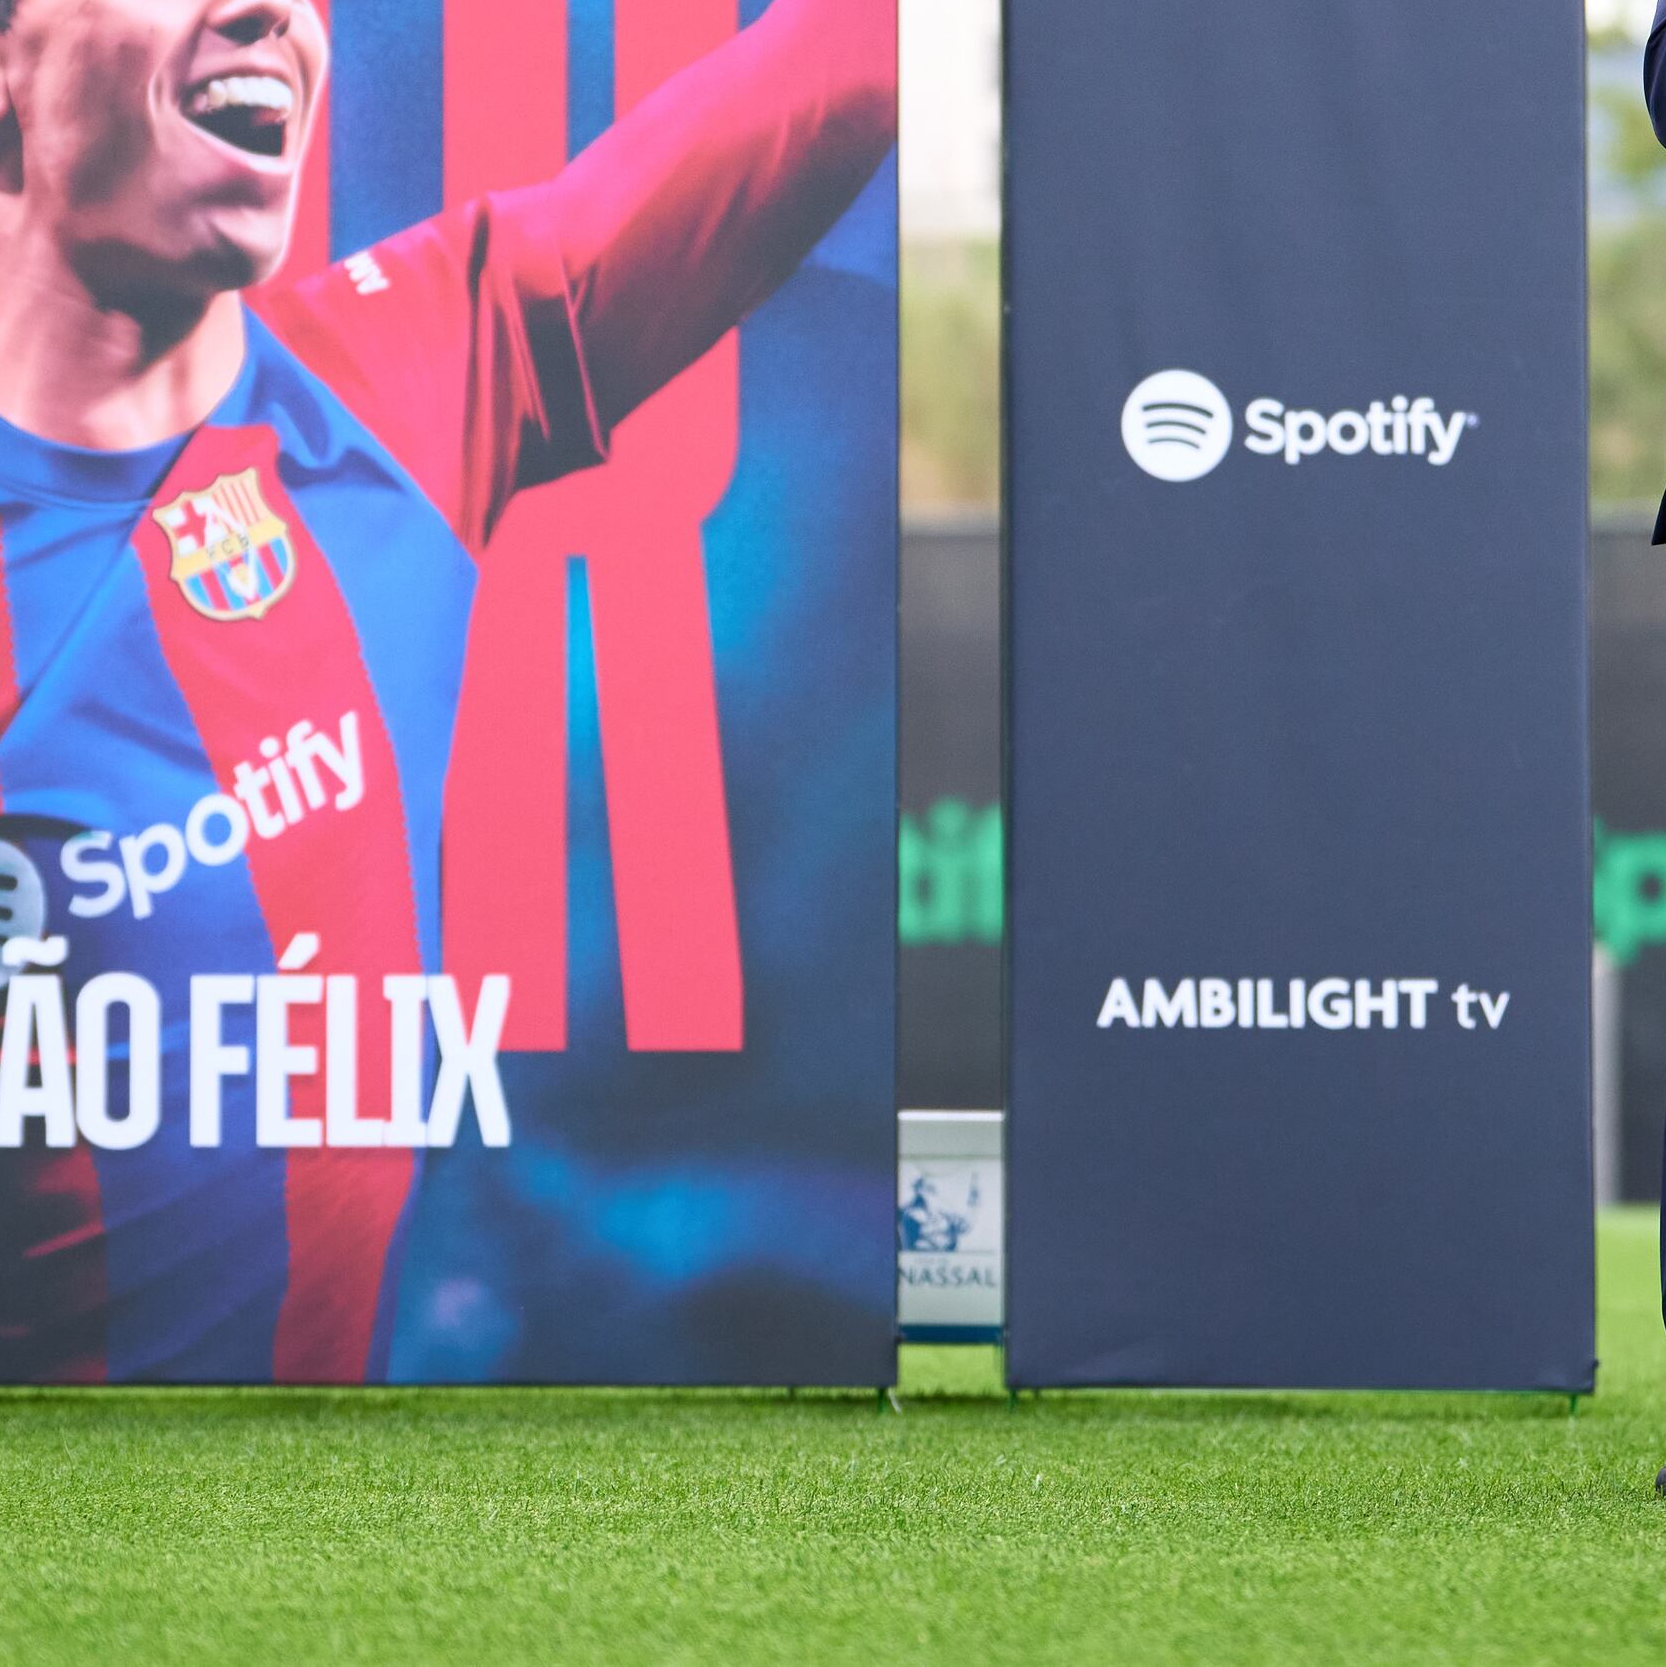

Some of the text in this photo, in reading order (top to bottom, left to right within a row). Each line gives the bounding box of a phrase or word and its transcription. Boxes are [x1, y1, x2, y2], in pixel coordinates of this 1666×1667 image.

[1244, 395, 1467, 465] Spotify
[59, 711, 367, 920] Spotify
[189, 934, 513, 1149] FÉLIX
[1096, 978, 1511, 1030] AMBILIGHT tv
